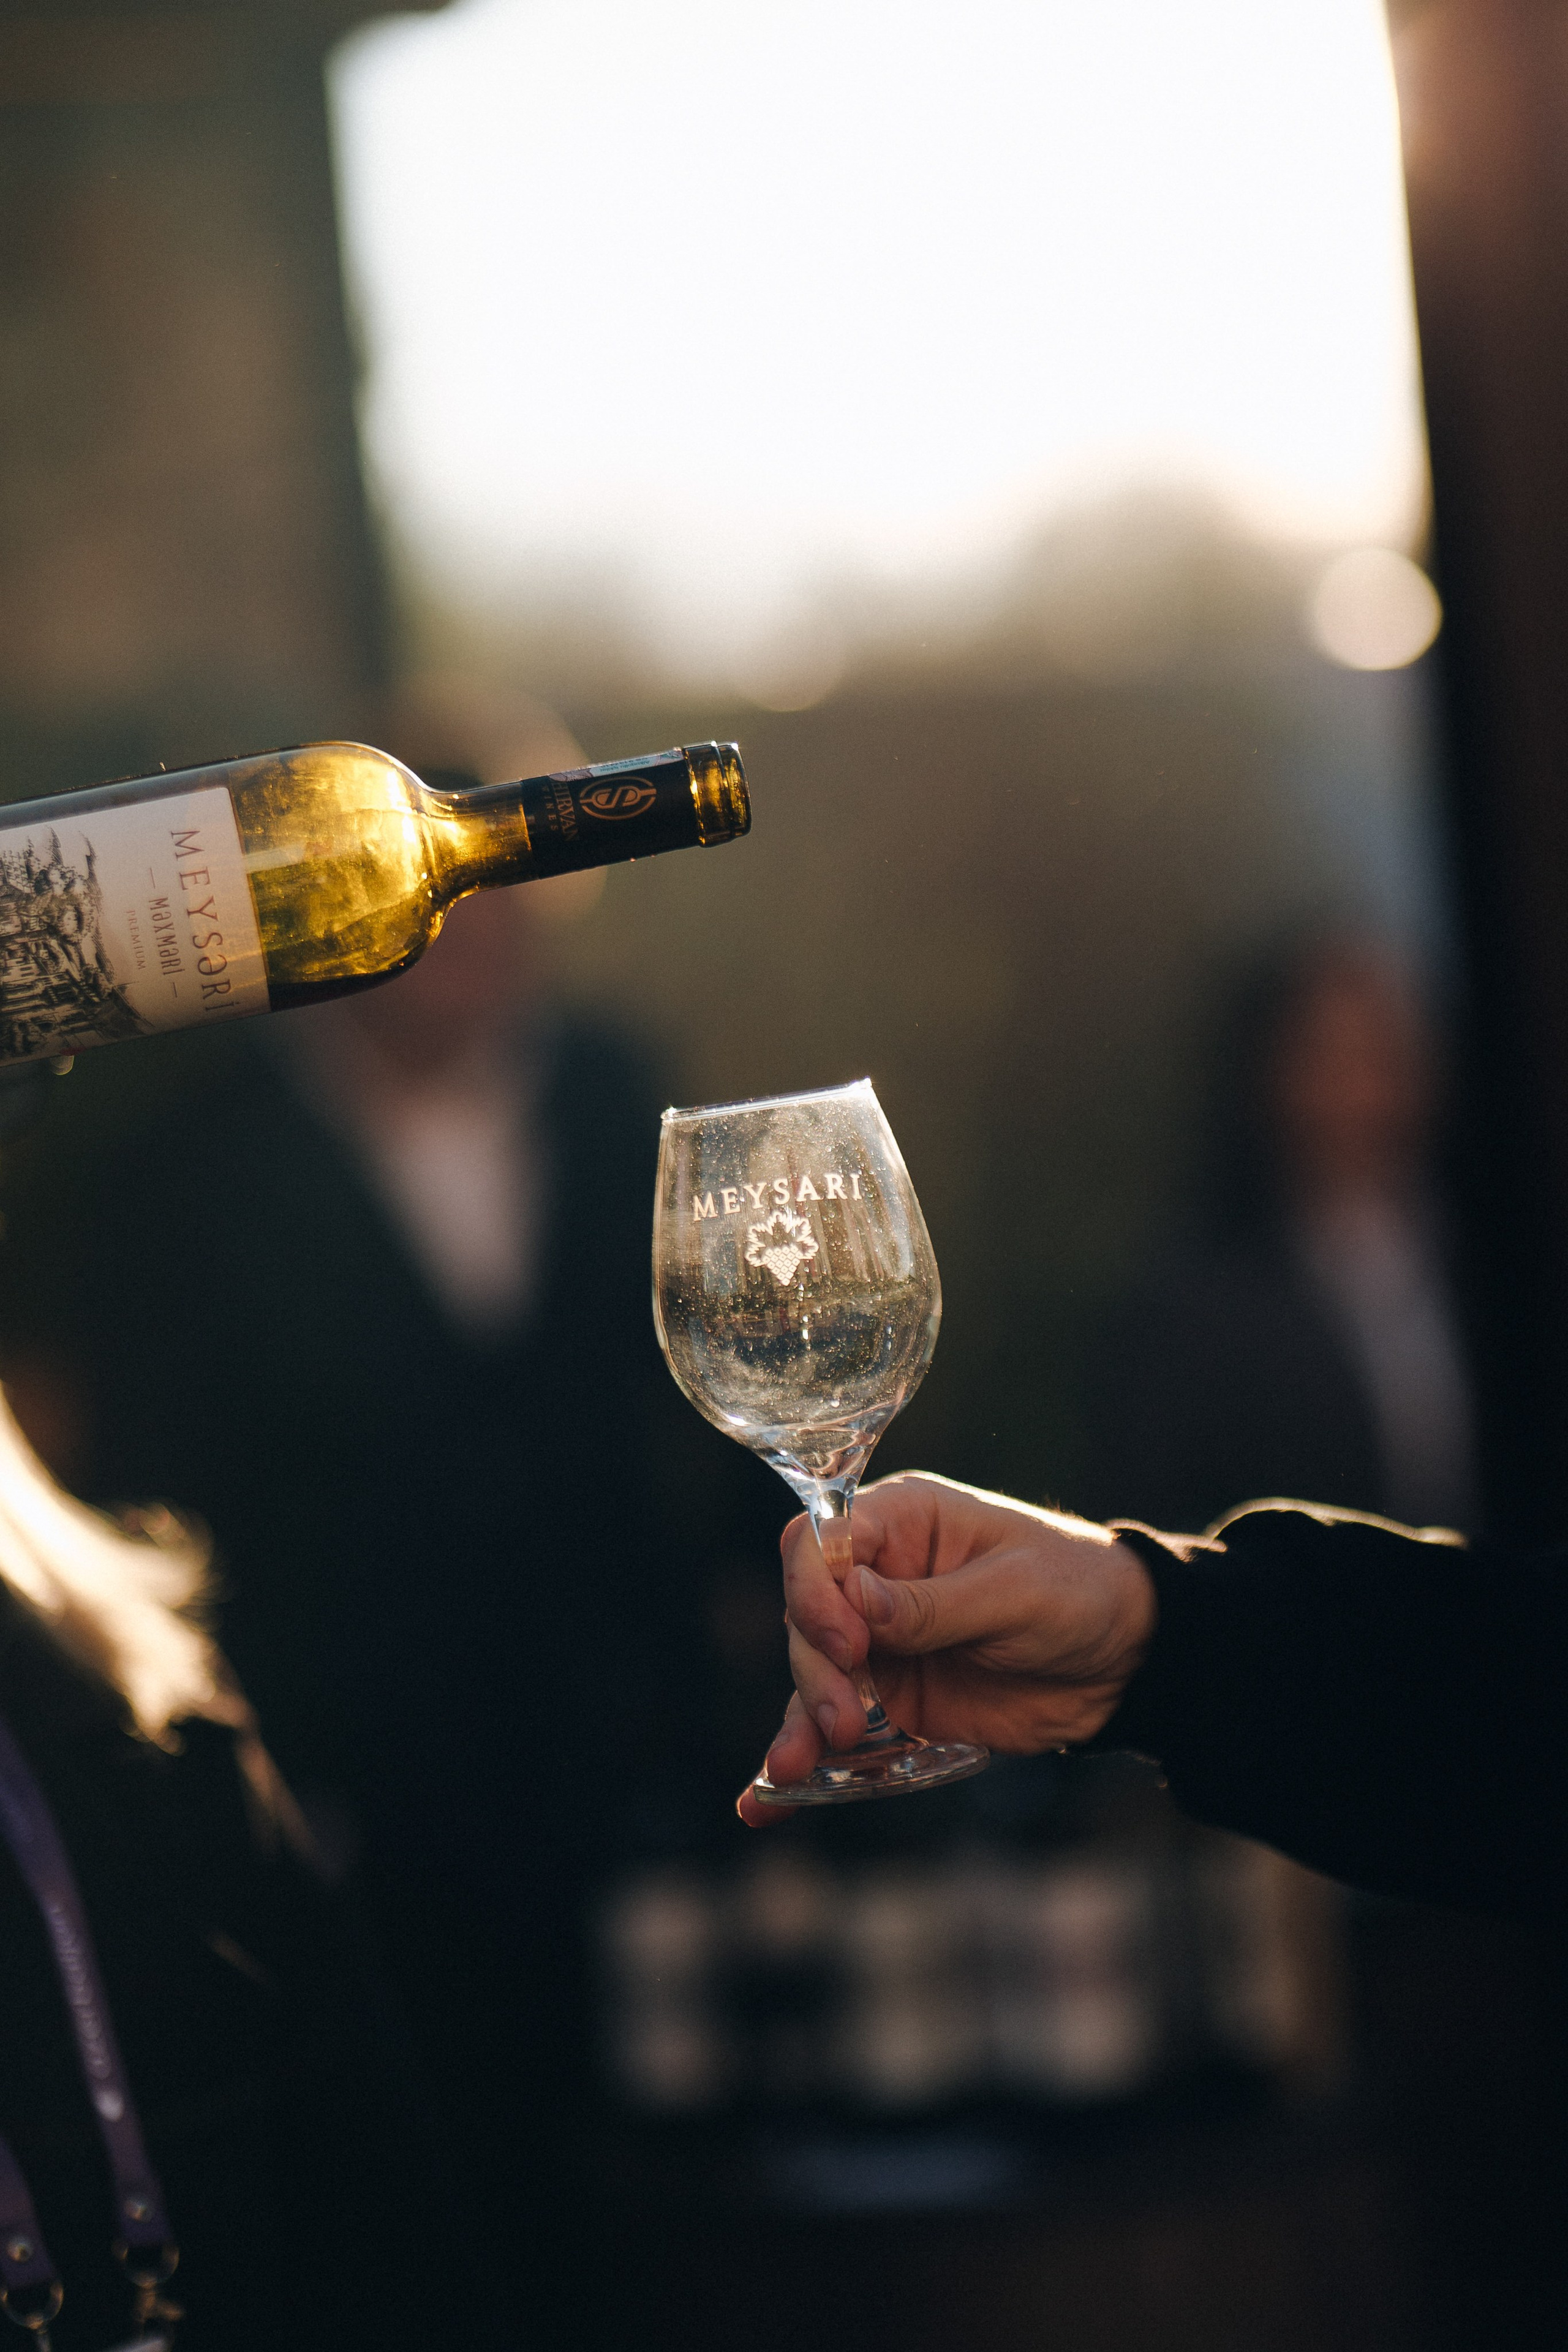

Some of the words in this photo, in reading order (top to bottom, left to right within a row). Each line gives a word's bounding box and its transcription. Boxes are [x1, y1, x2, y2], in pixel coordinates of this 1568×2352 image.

[542, 786, 559, 831] WINES
[551, 782, 580, 841] HIRVAN
[693, 1172, 863, 1222] MEYSARI
